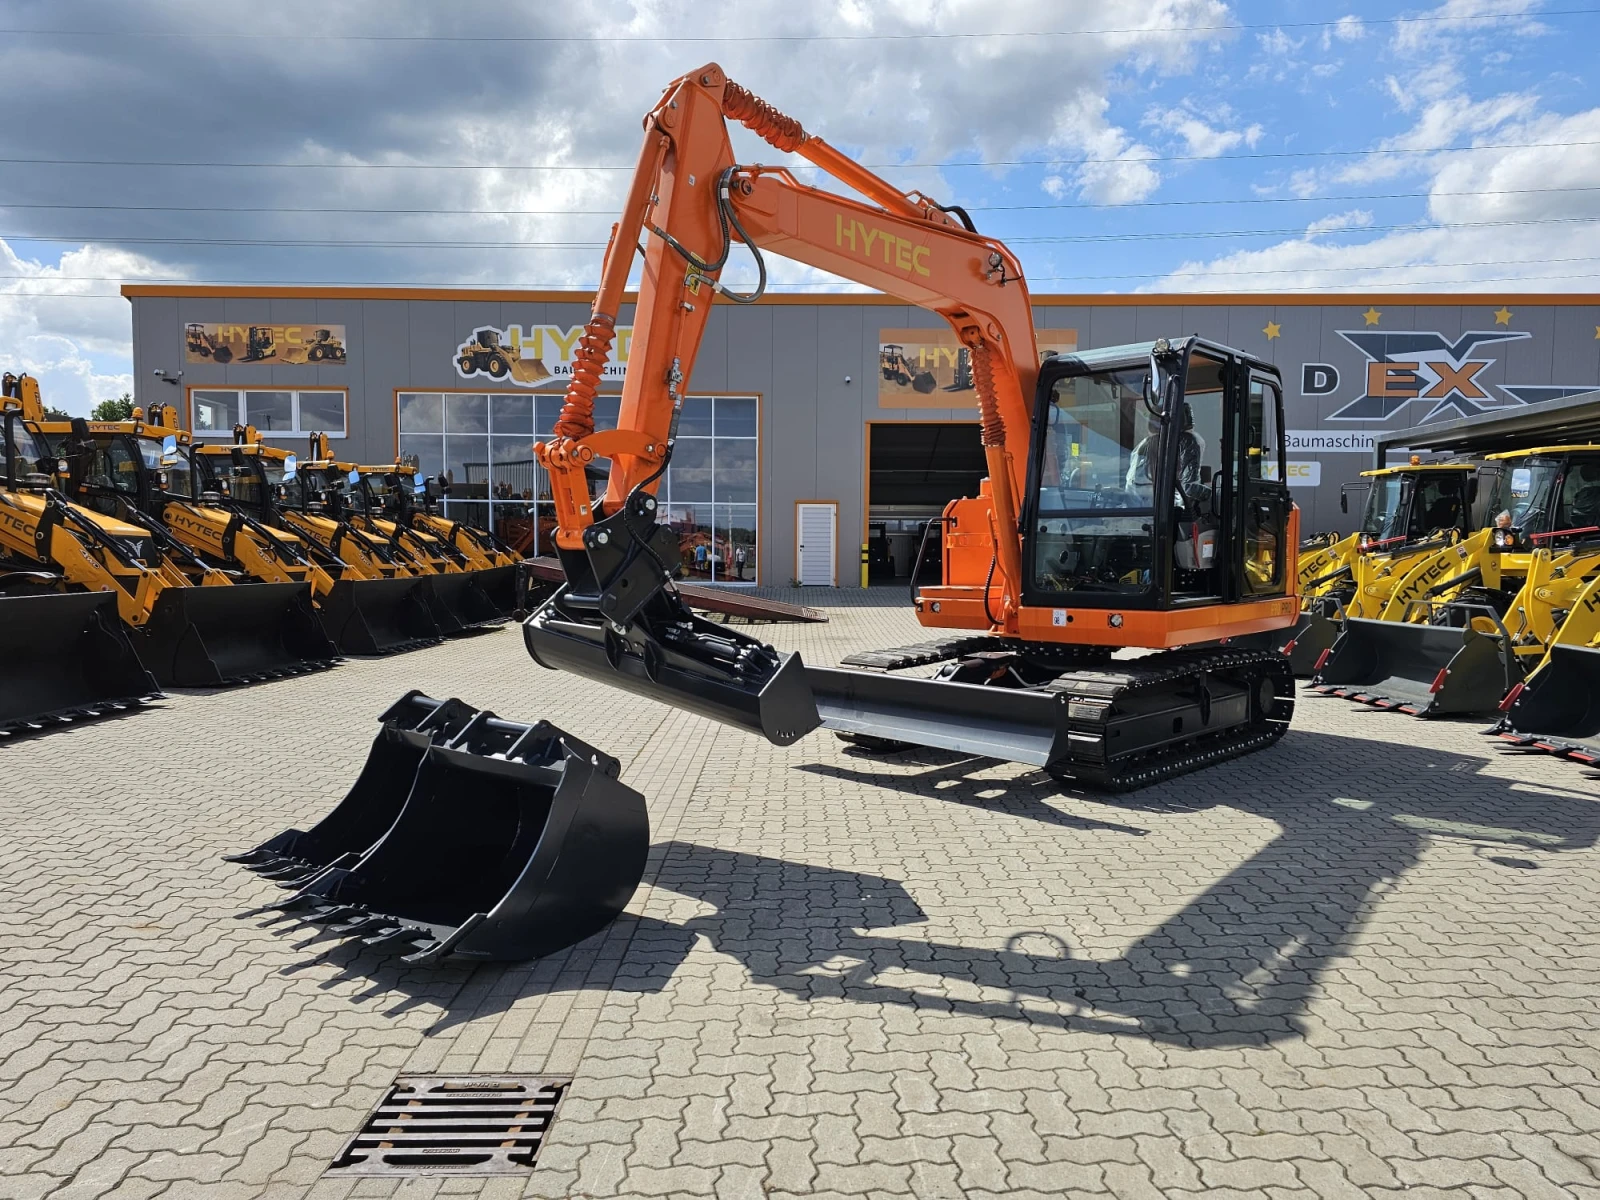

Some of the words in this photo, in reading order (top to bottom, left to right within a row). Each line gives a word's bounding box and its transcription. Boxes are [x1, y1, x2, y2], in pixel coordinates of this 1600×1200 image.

[836, 214, 930, 277] HYTEC
[217, 326, 302, 344] HYEC
[1284, 434, 1374, 448] Baumaschin
[175, 513, 222, 541] HYTEC
[80, 549, 100, 569] 4WD
[1298, 555, 1328, 585] TEC
[1396, 556, 1451, 605] HYTEC
